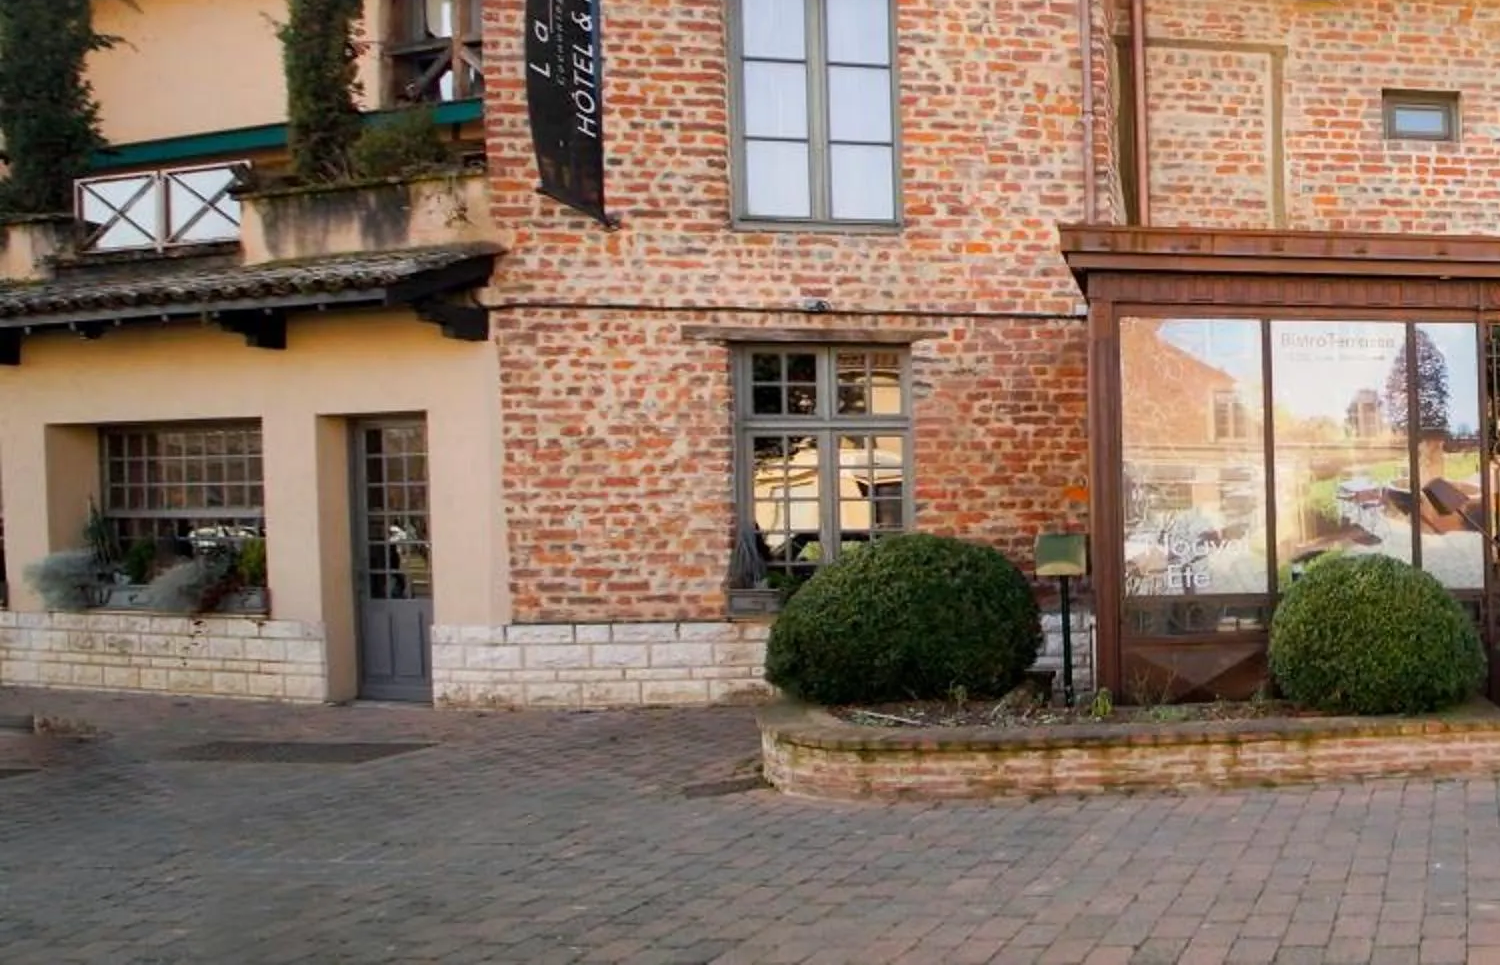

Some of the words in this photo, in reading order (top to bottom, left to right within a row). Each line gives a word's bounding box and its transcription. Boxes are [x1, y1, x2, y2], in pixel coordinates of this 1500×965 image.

[529, 19, 551, 79] La
[570, 10, 593, 33] &
[571, 43, 597, 138] HÔTEL
